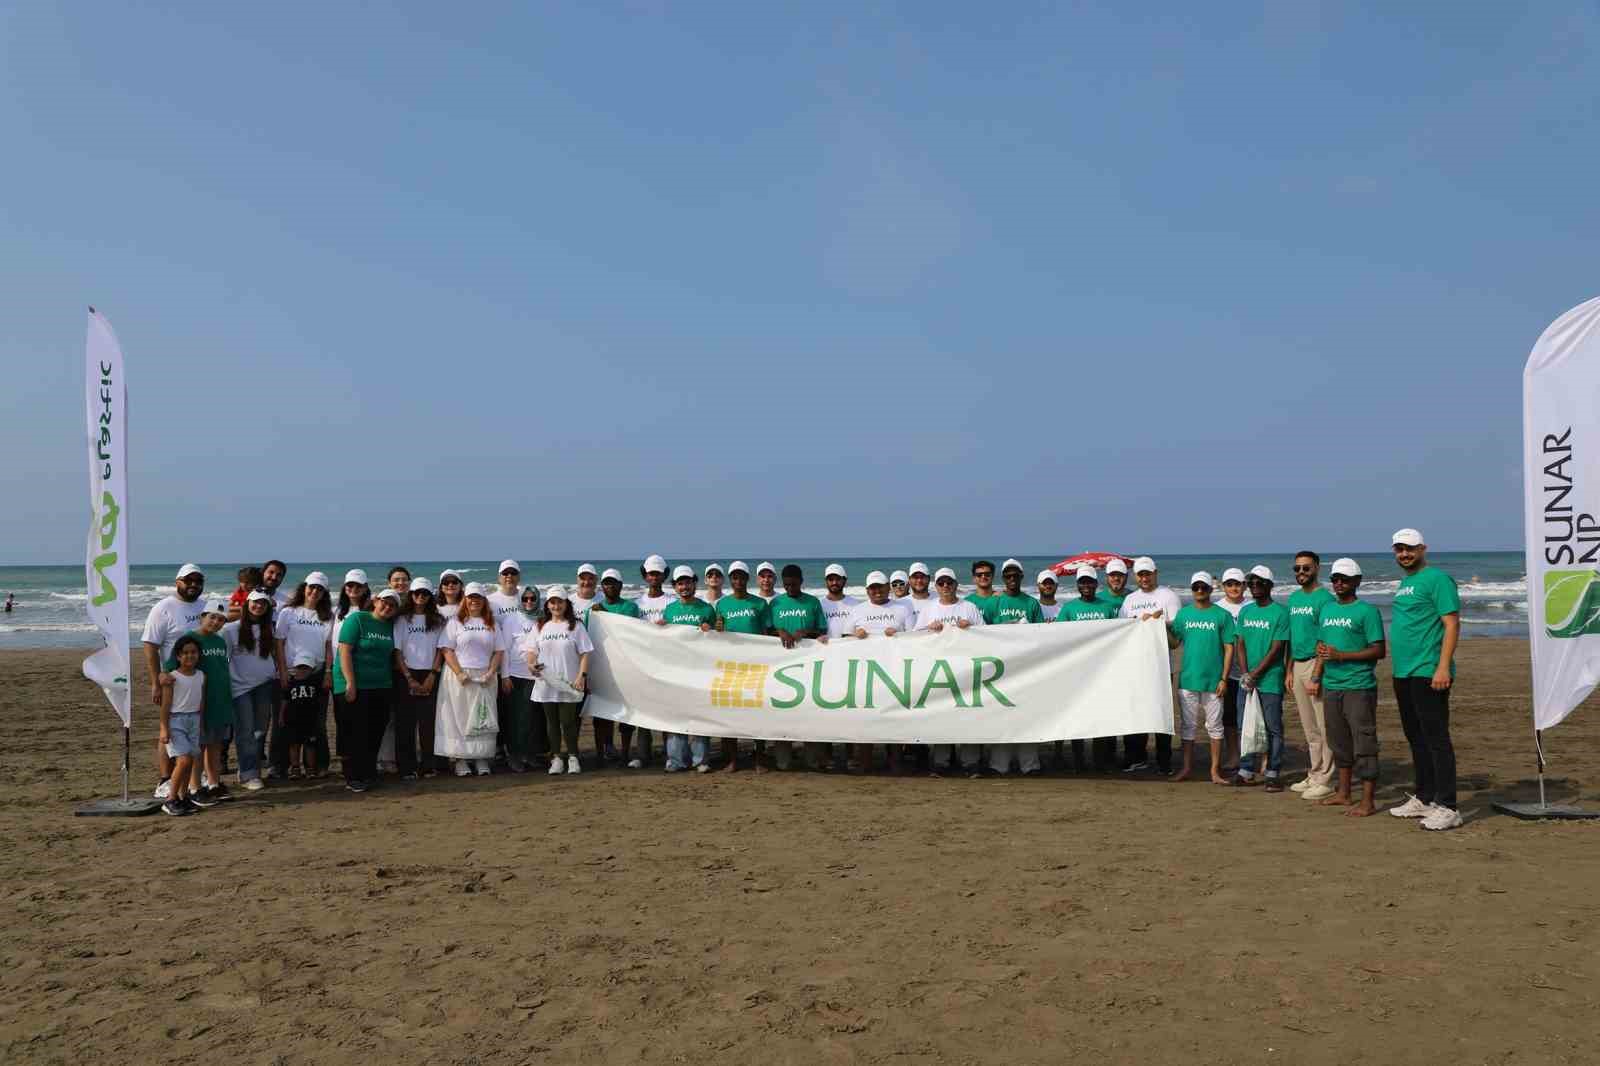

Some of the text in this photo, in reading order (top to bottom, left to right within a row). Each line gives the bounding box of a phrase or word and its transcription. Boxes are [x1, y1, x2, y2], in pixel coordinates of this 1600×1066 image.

[1543, 426, 1575, 565] SUNAR
[727, 608, 756, 618] SUNAR
[779, 609, 807, 618] SUNAR
[1000, 608, 1028, 618] SUNAR
[1290, 606, 1314, 616] SUNAR
[672, 614, 700, 623] SUNAR
[1323, 618, 1353, 628] SUNAR
[1185, 621, 1216, 630] SUNAR
[1243, 620, 1270, 630] SUNAR
[770, 656, 1016, 710] SUNAR
